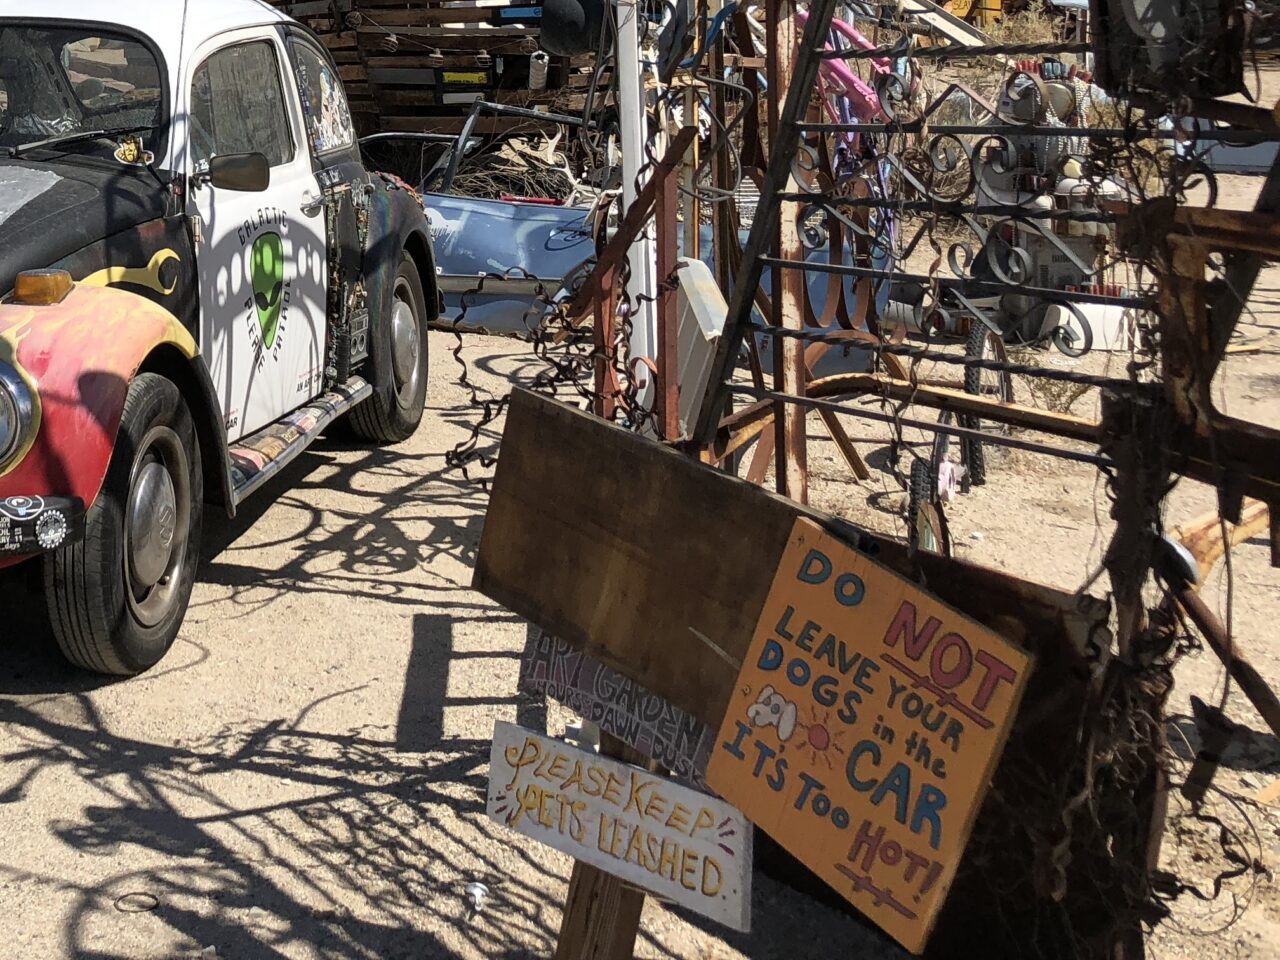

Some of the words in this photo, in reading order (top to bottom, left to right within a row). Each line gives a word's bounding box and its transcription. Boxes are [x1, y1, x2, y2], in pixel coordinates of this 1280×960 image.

[237, 206, 288, 246] GALACTIC
[273, 275, 292, 362] PATROL
[796, 548, 866, 607] DO
[774, 605, 881, 695] LEAVE
[886, 674, 965, 753] YOUR
[882, 599, 1018, 712] NOT
[757, 638, 863, 725] DOGS
[872, 714, 896, 745] in
[904, 730, 947, 780] the
[505, 737, 626, 806] PLEASE
[623, 771, 716, 838] KEEP
[722, 719, 789, 792] IT'S
[845, 739, 948, 851] CAR
[509, 783, 588, 844] PETS
[847, 819, 945, 904] HOT!
